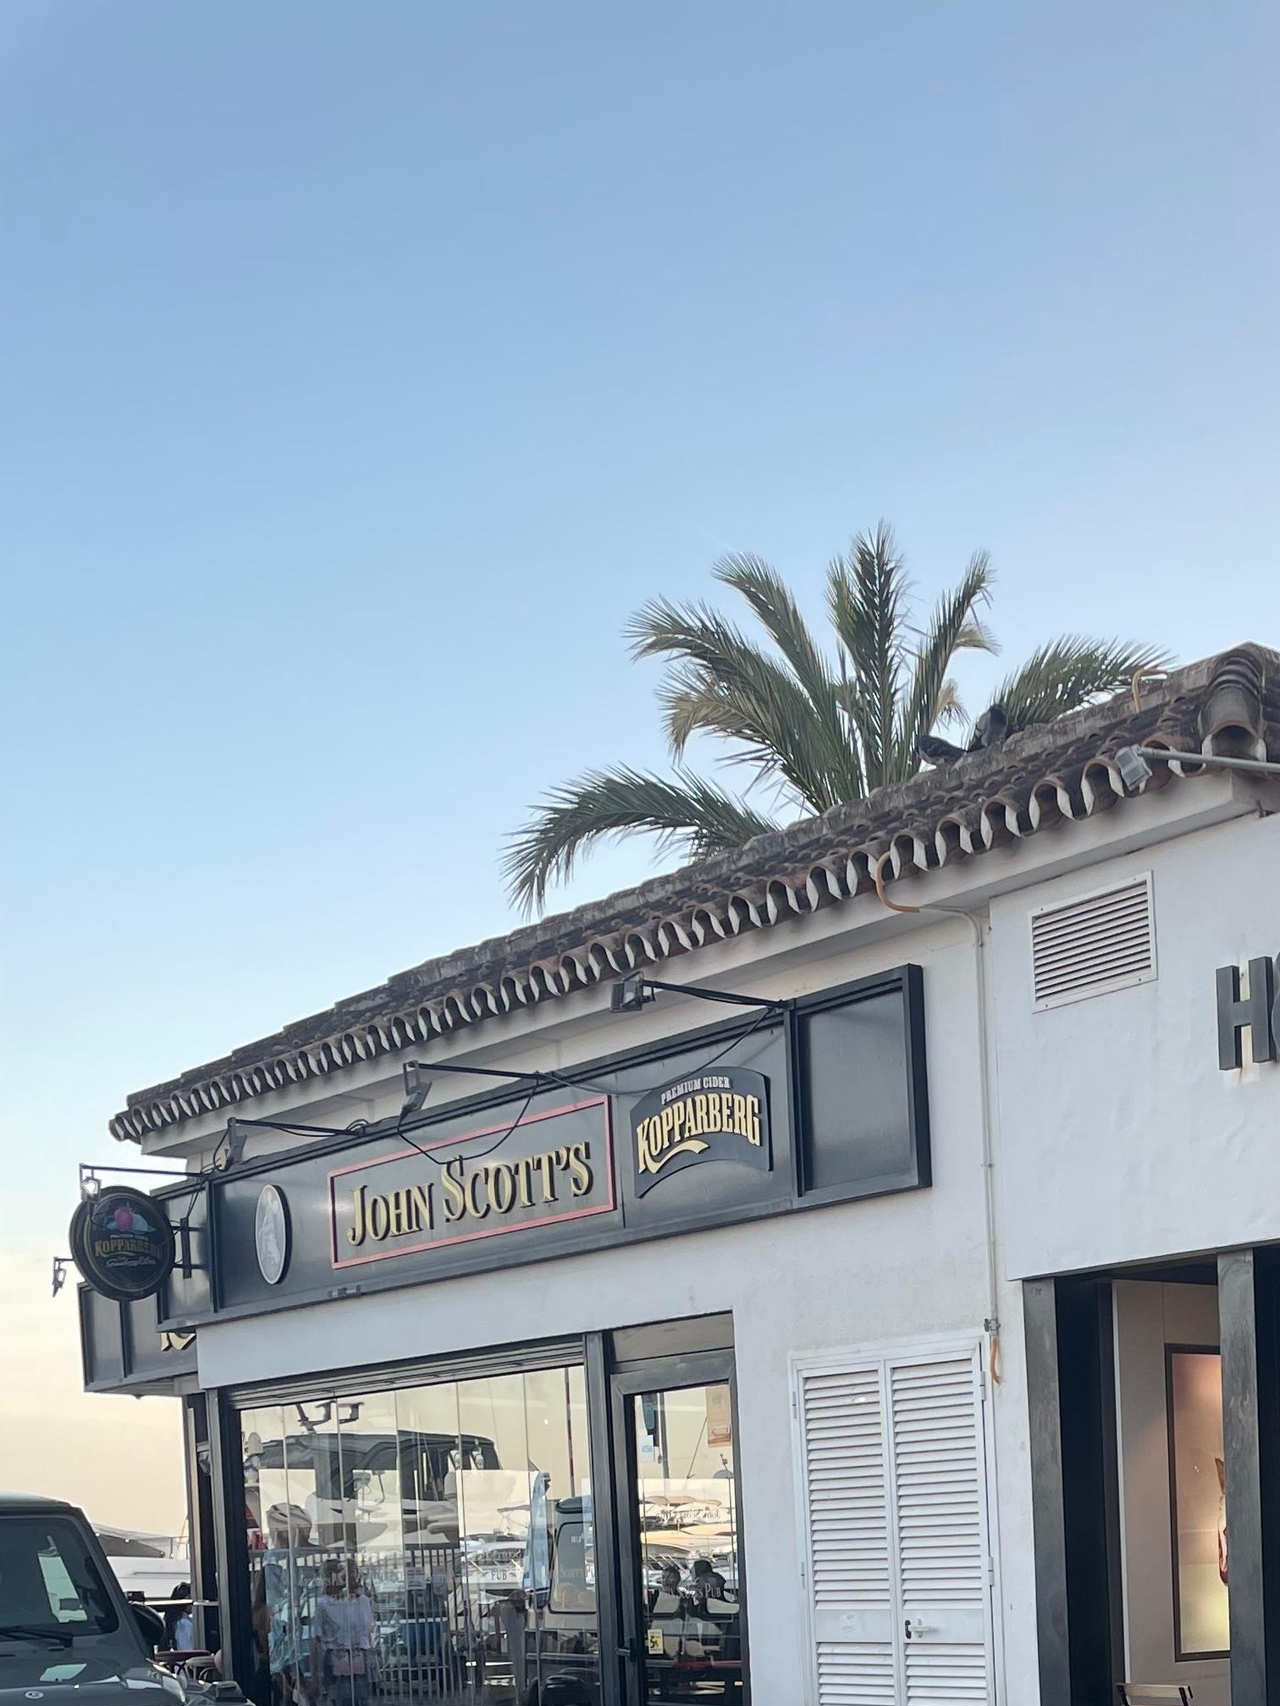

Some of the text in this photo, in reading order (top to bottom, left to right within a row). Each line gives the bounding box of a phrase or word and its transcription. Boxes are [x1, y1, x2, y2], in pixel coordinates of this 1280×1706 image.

[661, 1076, 731, 1105] PREMIUM CIDER
[637, 1093, 761, 1174] KOPPARBERG
[347, 1141, 594, 1246] JOHN SCOTT'S
